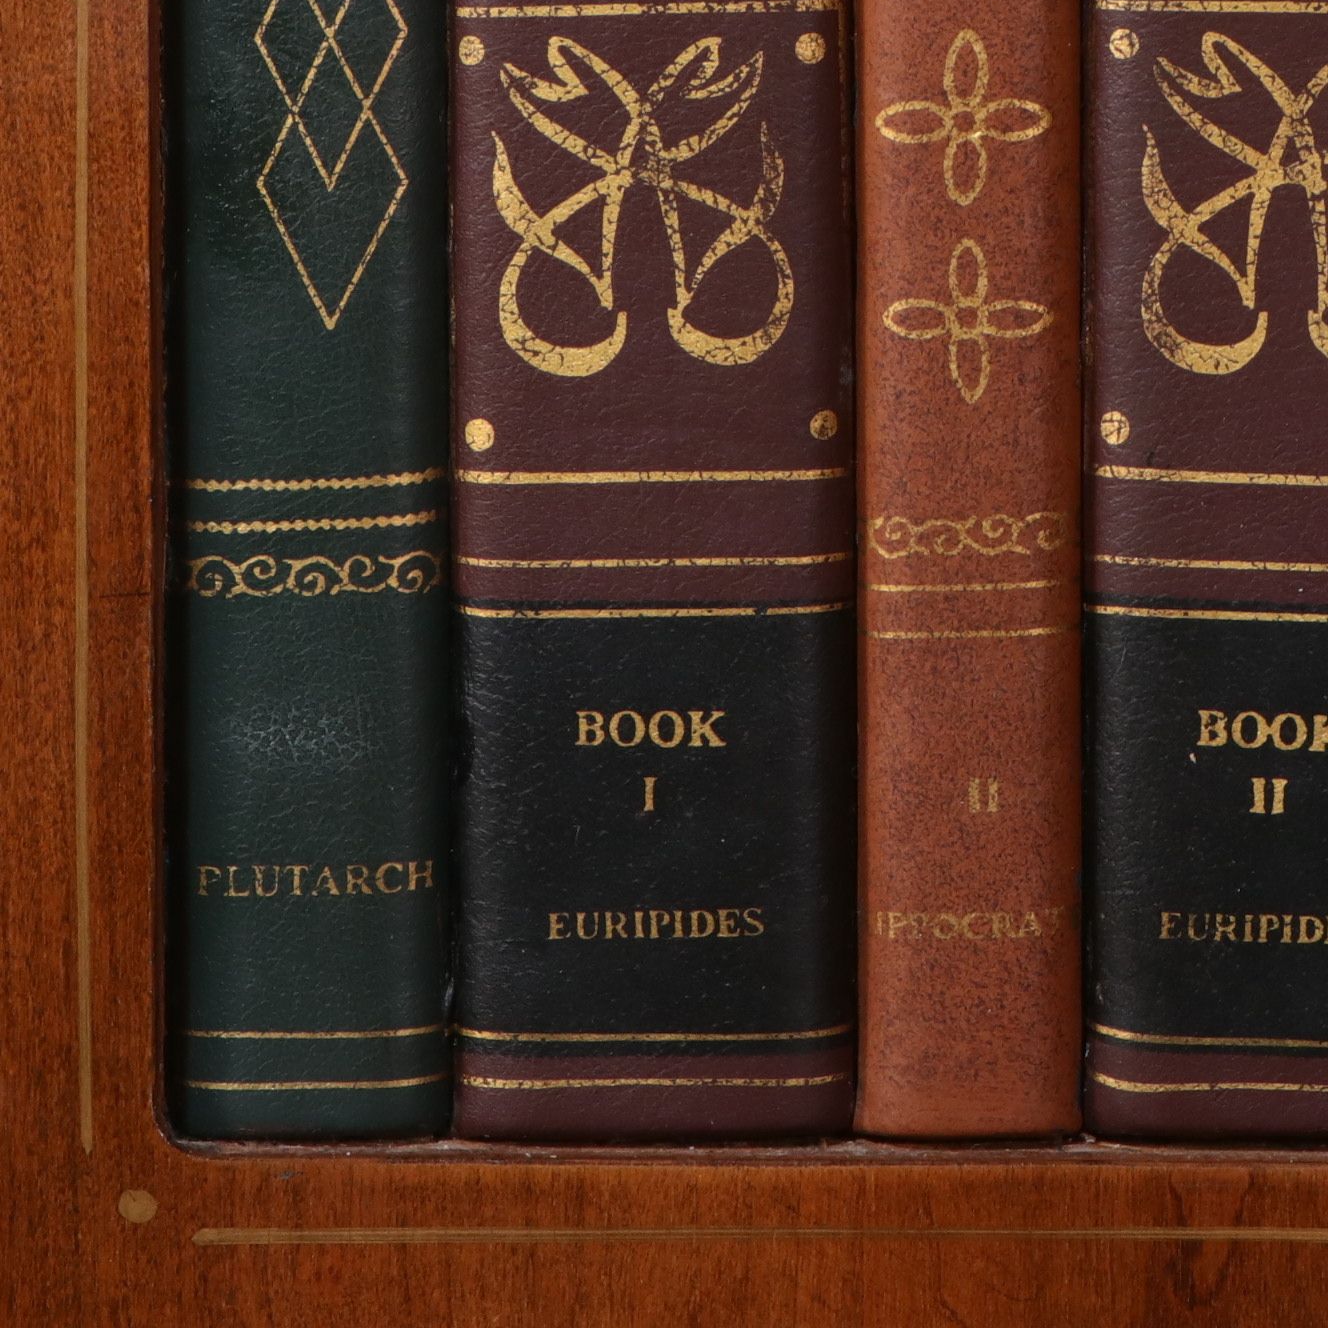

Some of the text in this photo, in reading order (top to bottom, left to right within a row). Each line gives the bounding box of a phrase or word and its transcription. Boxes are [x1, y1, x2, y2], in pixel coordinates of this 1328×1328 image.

[575, 710, 727, 748] BOOK
[643, 776, 657, 812] I
[968, 777, 999, 813] II
[1249, 777, 1288, 814] II
[199, 860, 433, 897] PLUTARCH
[548, 907, 765, 940] EURIPIDES
